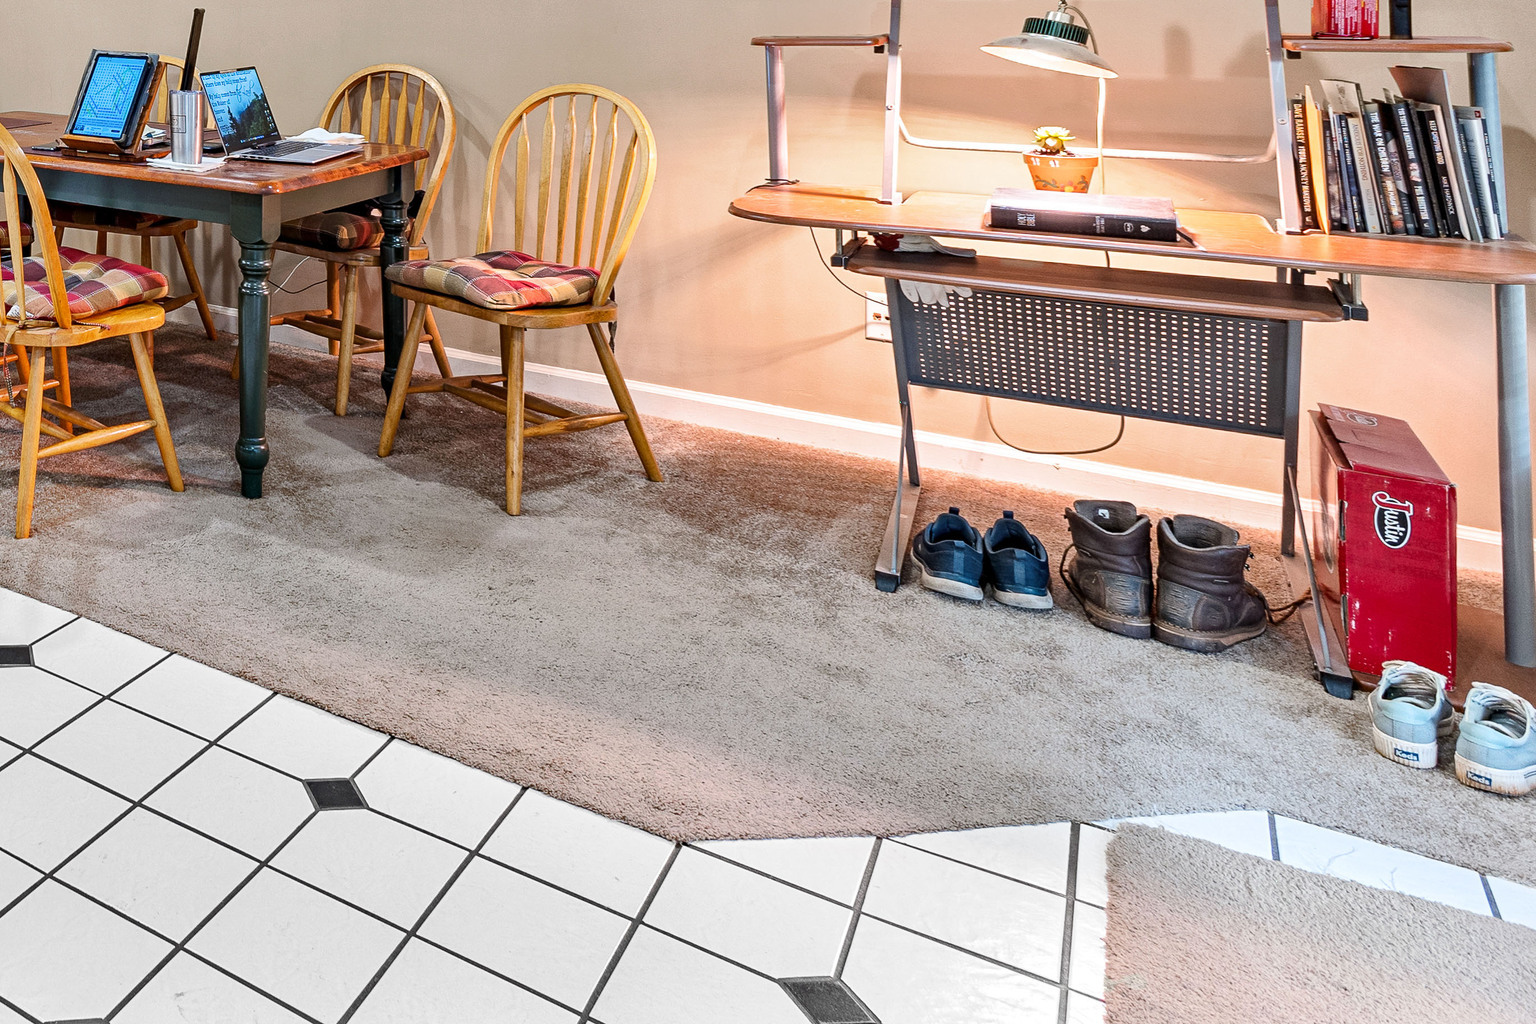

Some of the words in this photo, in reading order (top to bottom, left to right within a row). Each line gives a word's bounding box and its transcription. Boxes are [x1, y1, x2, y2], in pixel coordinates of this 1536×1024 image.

[1293, 103, 1303, 118] DAVE
[1370, 112, 1379, 124] THE
[1295, 118, 1306, 144] RAMSEY
[1372, 123, 1383, 138] WAR
[1376, 137, 1384, 146] ON
[1428, 119, 1437, 132] KEEP
[1435, 151, 1444, 165] WOOD
[1298, 147, 1308, 163] TOTAL
[1378, 146, 1390, 173] CHILDREN
[1299, 163, 1309, 186] MONEY
[1358, 157, 1368, 181] NOTHING
[1302, 185, 1312, 212] MAKEOVER
[1372, 490, 1413, 547] Justin
[1396, 749, 1419, 761] Keds
[1468, 771, 1491, 785] Keds
